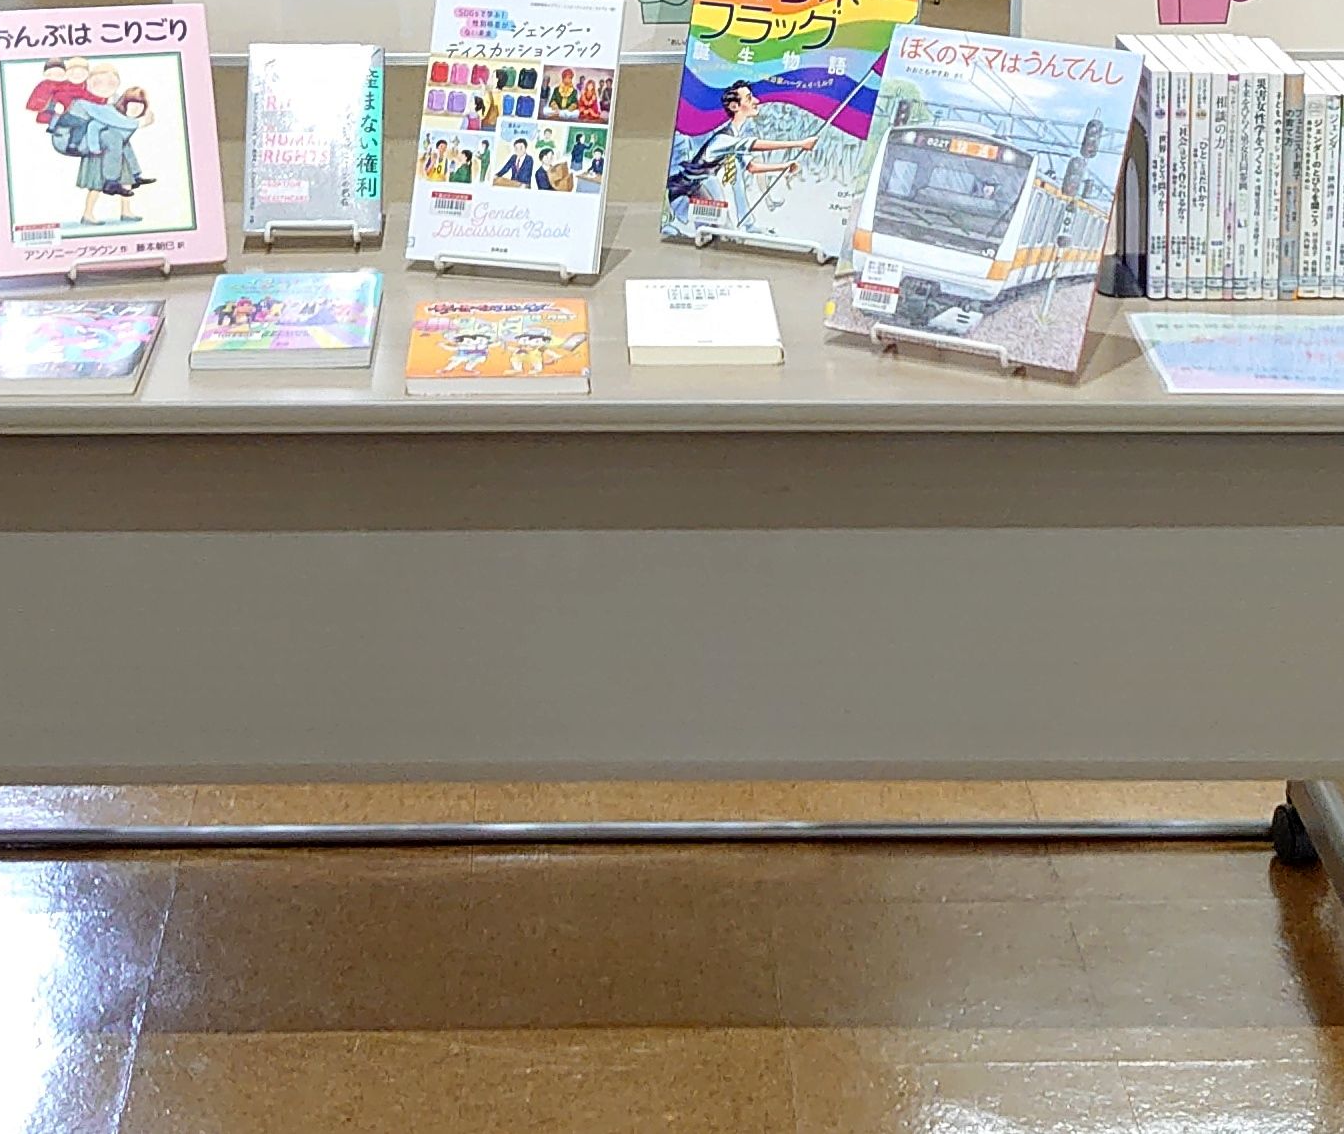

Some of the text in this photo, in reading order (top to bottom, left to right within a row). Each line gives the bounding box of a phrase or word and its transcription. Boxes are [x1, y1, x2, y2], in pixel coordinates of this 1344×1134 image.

[100, 18, 188, 44] こりごり
[698, 0, 842, 50] フラッグ
[899, 36, 1125, 85] ぼくのママはうんてんし
[471, 202, 530, 226] Gender
[432, 219, 571, 240] Discussion Book
